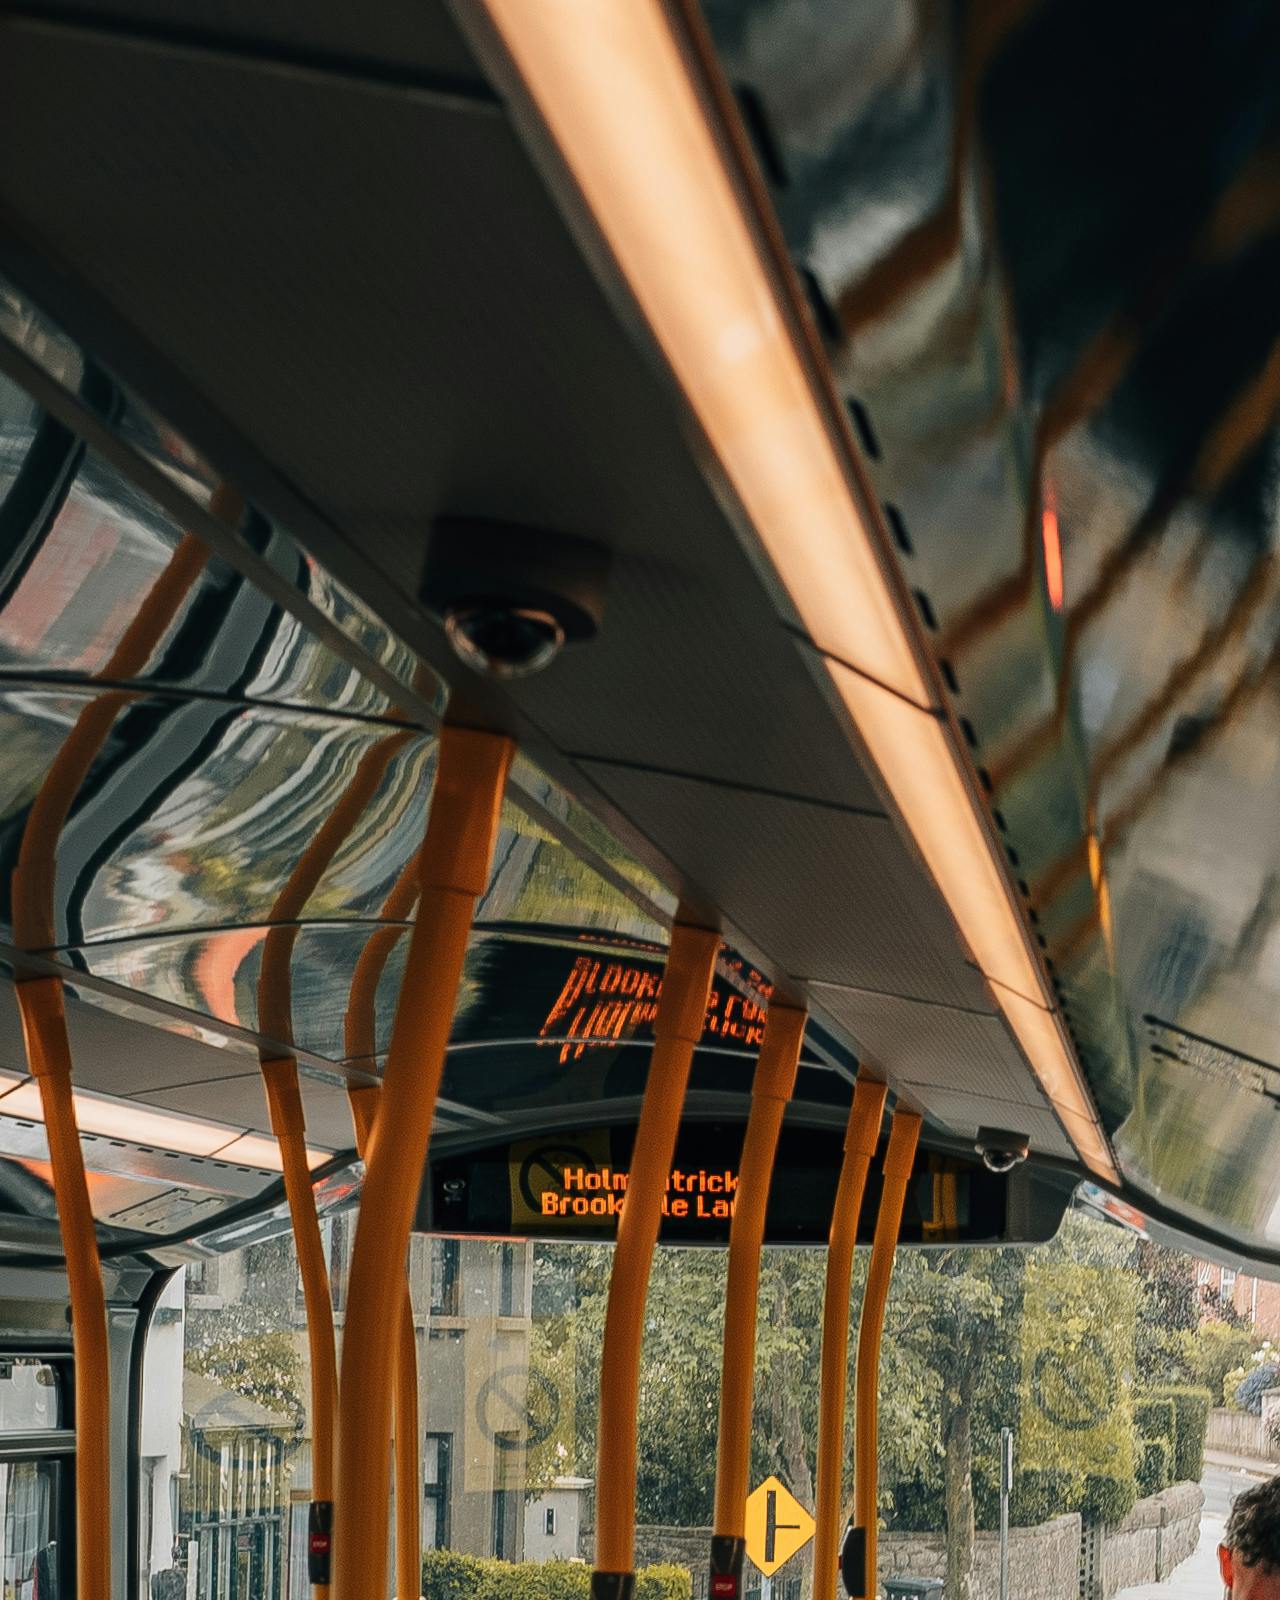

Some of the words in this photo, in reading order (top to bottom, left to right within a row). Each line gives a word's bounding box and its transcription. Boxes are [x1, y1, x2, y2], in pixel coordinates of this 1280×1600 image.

[563, 1167, 740, 1192] Holmtrick
[541, 1191, 689, 1217] Brookle
[696, 1195, 737, 1218] La
[312, 1540, 328, 1549] STOP
[715, 1582, 734, 1592] STOP
